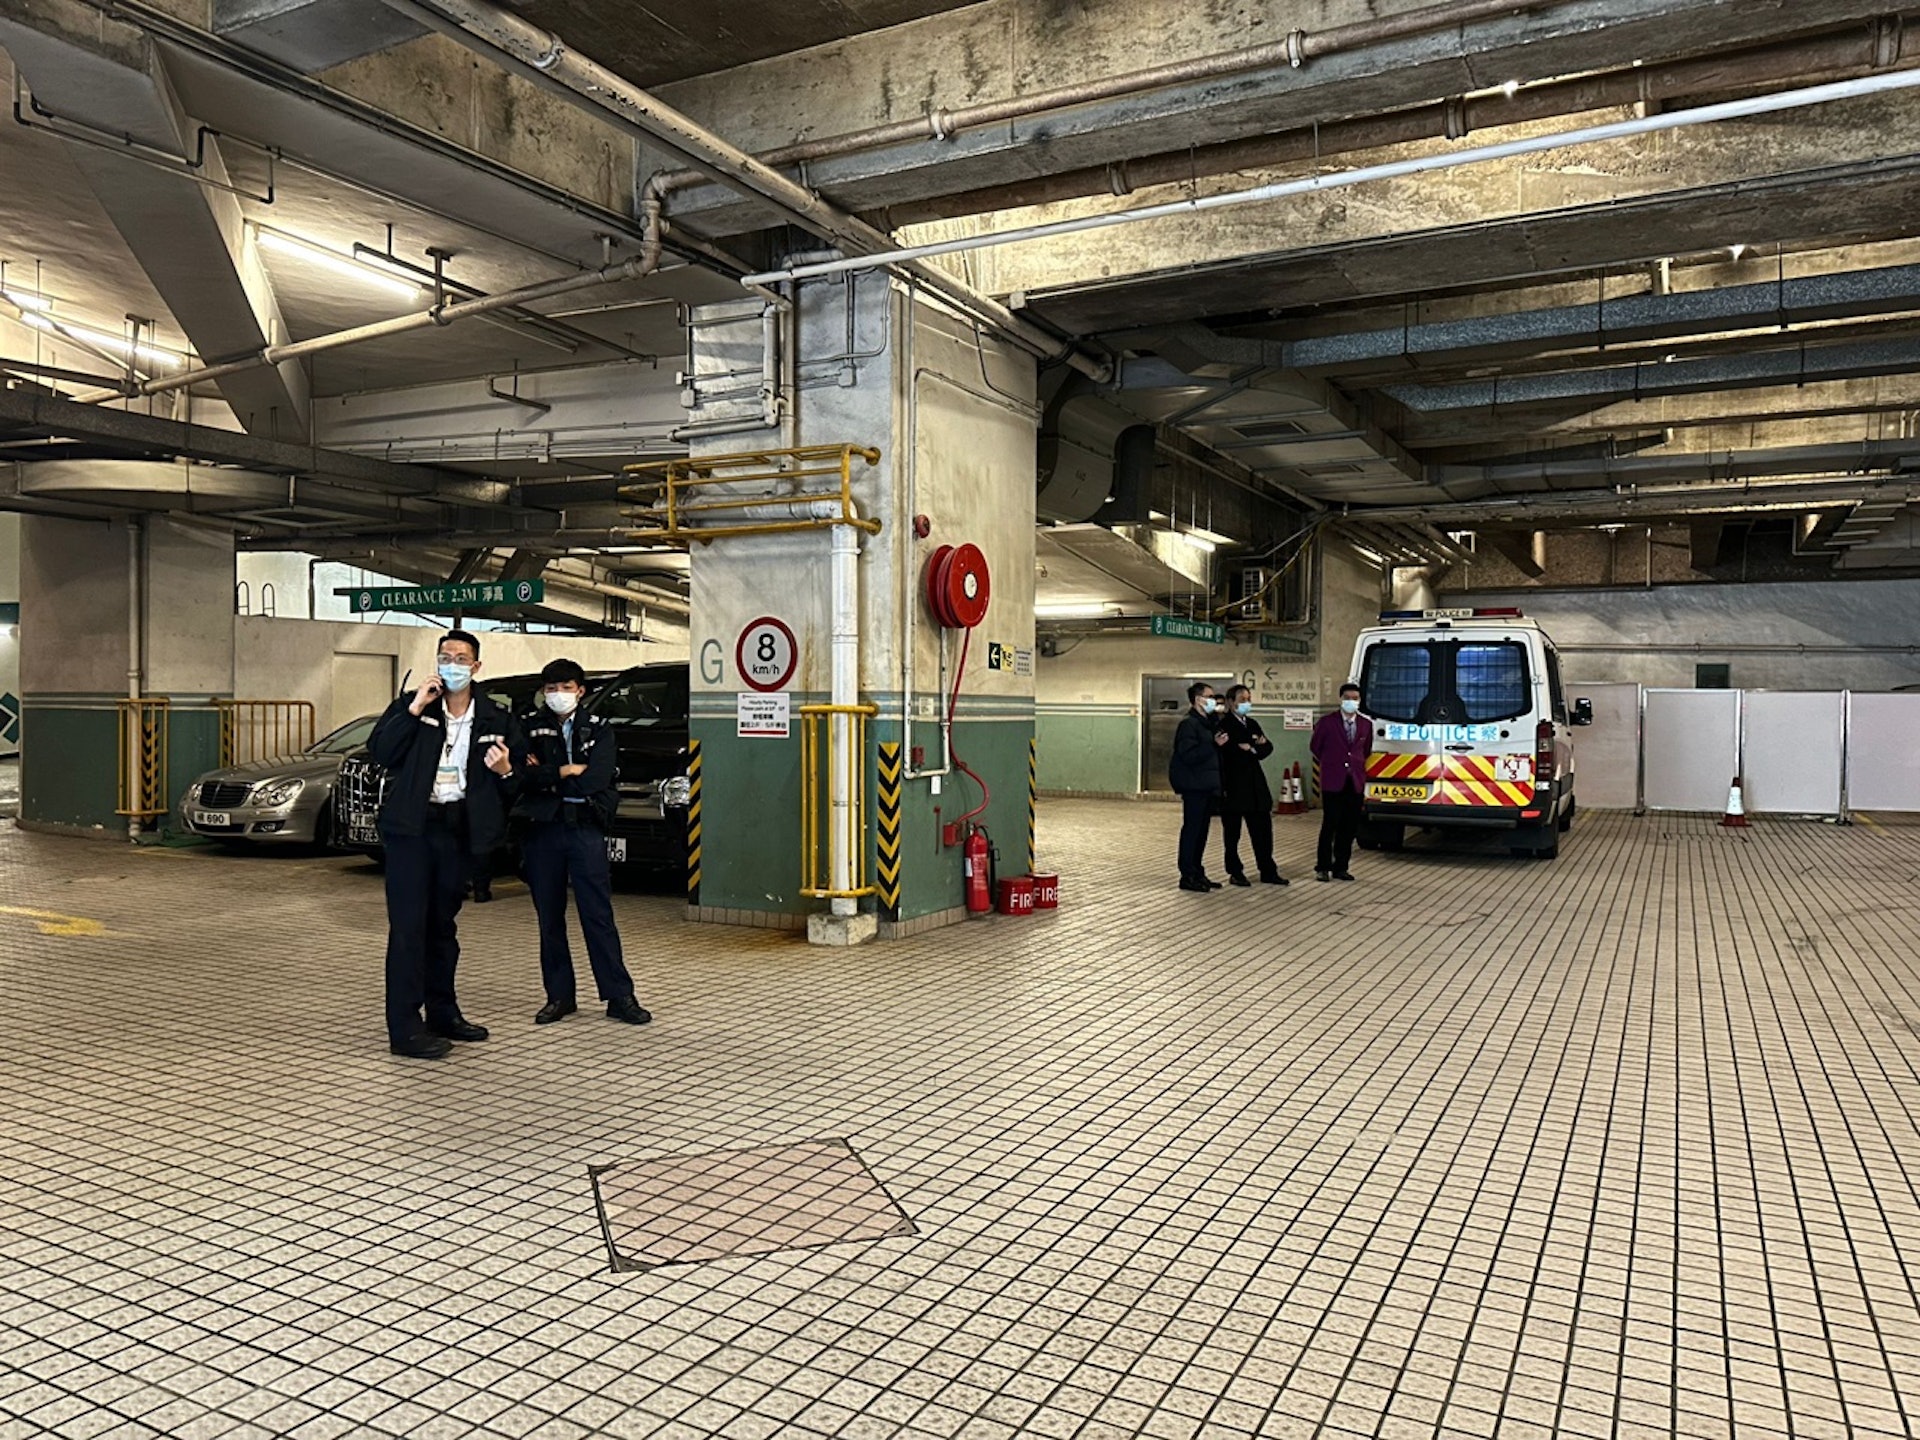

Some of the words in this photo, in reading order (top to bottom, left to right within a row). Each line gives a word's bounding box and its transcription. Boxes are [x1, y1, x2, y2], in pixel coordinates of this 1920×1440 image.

[381, 590, 445, 607] CLEARANCE
[451, 588, 477, 602] 2.3M
[1436, 609, 1460, 618] POLICE
[757, 633, 776, 662] 8
[700, 638, 723, 684] G
[752, 664, 779, 675] km/h
[1242, 669, 1256, 690] G
[1261, 692, 1285, 701] PRIVATE
[1286, 692, 1299, 701] CAR
[1299, 692, 1316, 701] ONLY
[1407, 723, 1477, 740] POLICE
[1509, 770, 1517, 780] 3
[1392, 787, 1423, 797] 6306
[207, 814, 224, 824] 690
[1010, 893, 1033, 909] FIR
